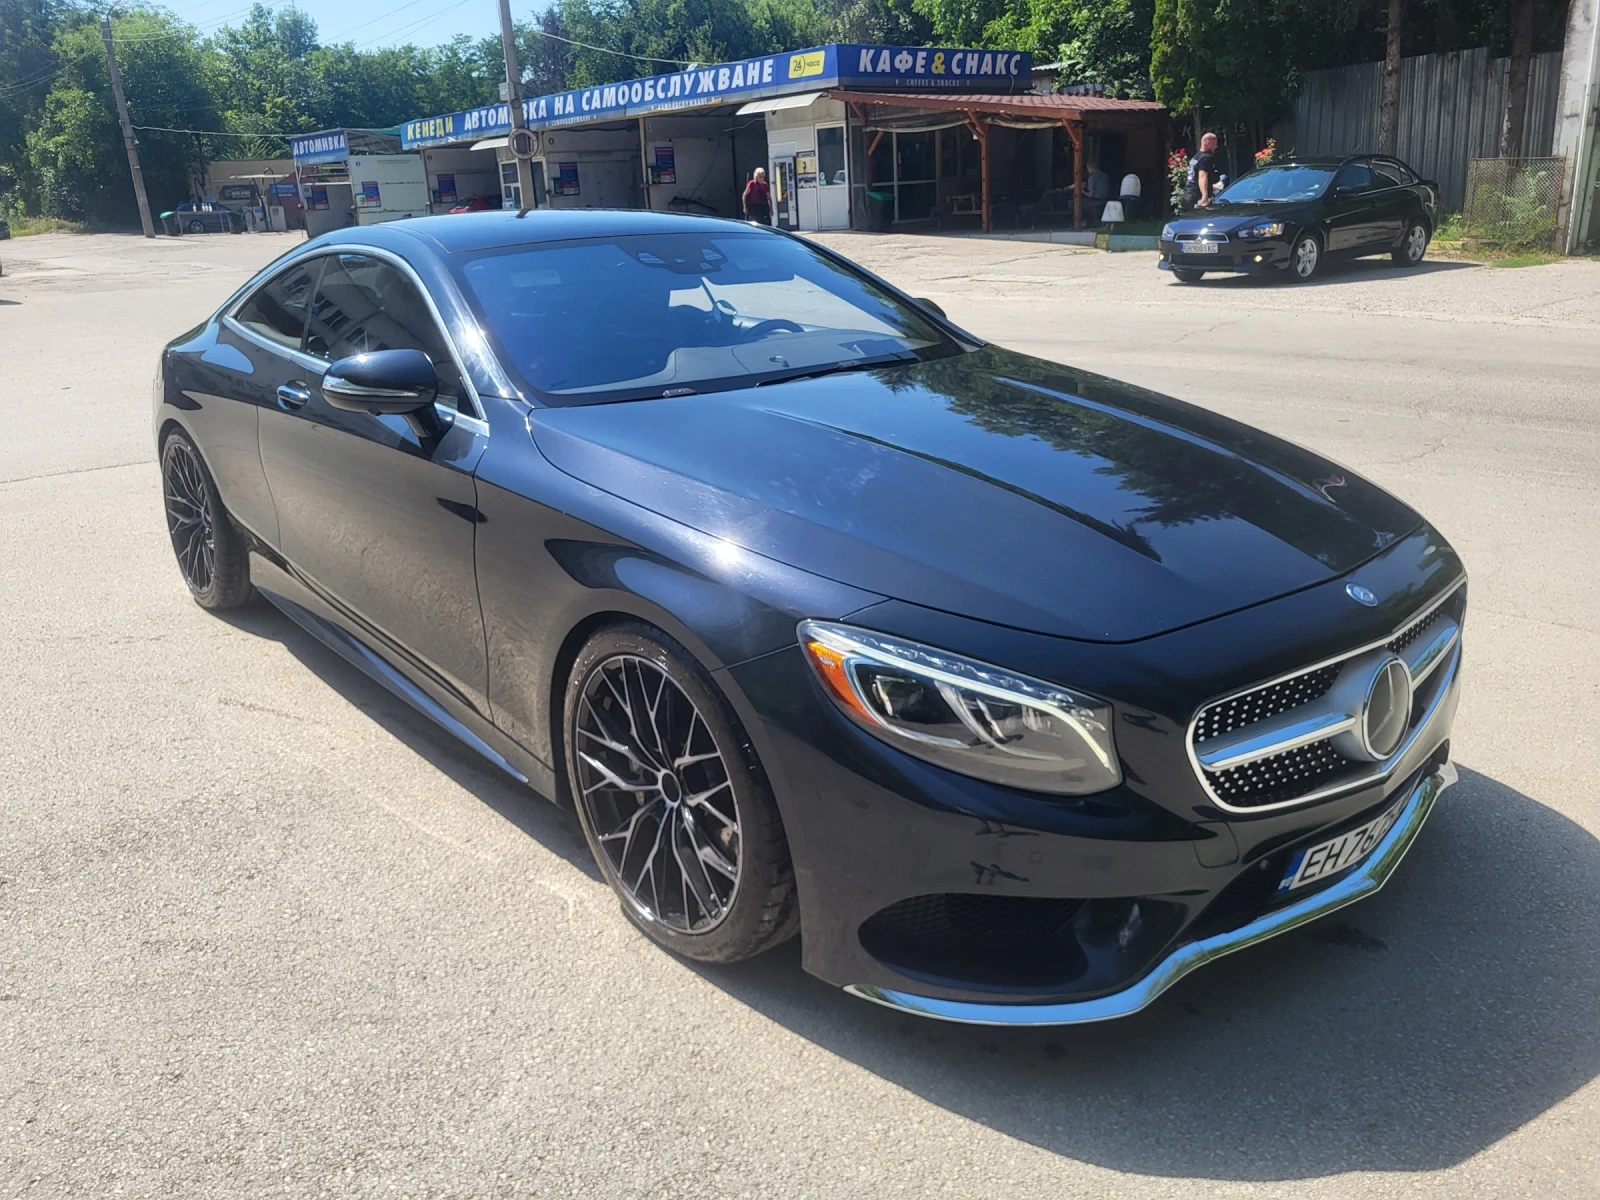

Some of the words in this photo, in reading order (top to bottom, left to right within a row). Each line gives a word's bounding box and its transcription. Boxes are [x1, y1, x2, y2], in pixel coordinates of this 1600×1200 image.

[793, 58, 802, 71] 24
[859, 49, 926, 74] КАФЕ
[931, 52, 946, 74] &
[952, 53, 1021, 76] СНАКС
[937, 79, 960, 87] SNACKS
[407, 116, 453, 140] КЕНЕДИ
[464, 99, 547, 130] АВТОМВКА
[554, 94, 575, 116] НА
[582, 59, 774, 111] САМООБСЛУЖВАНЕ
[293, 134, 346, 156] АВТОМИВКА
